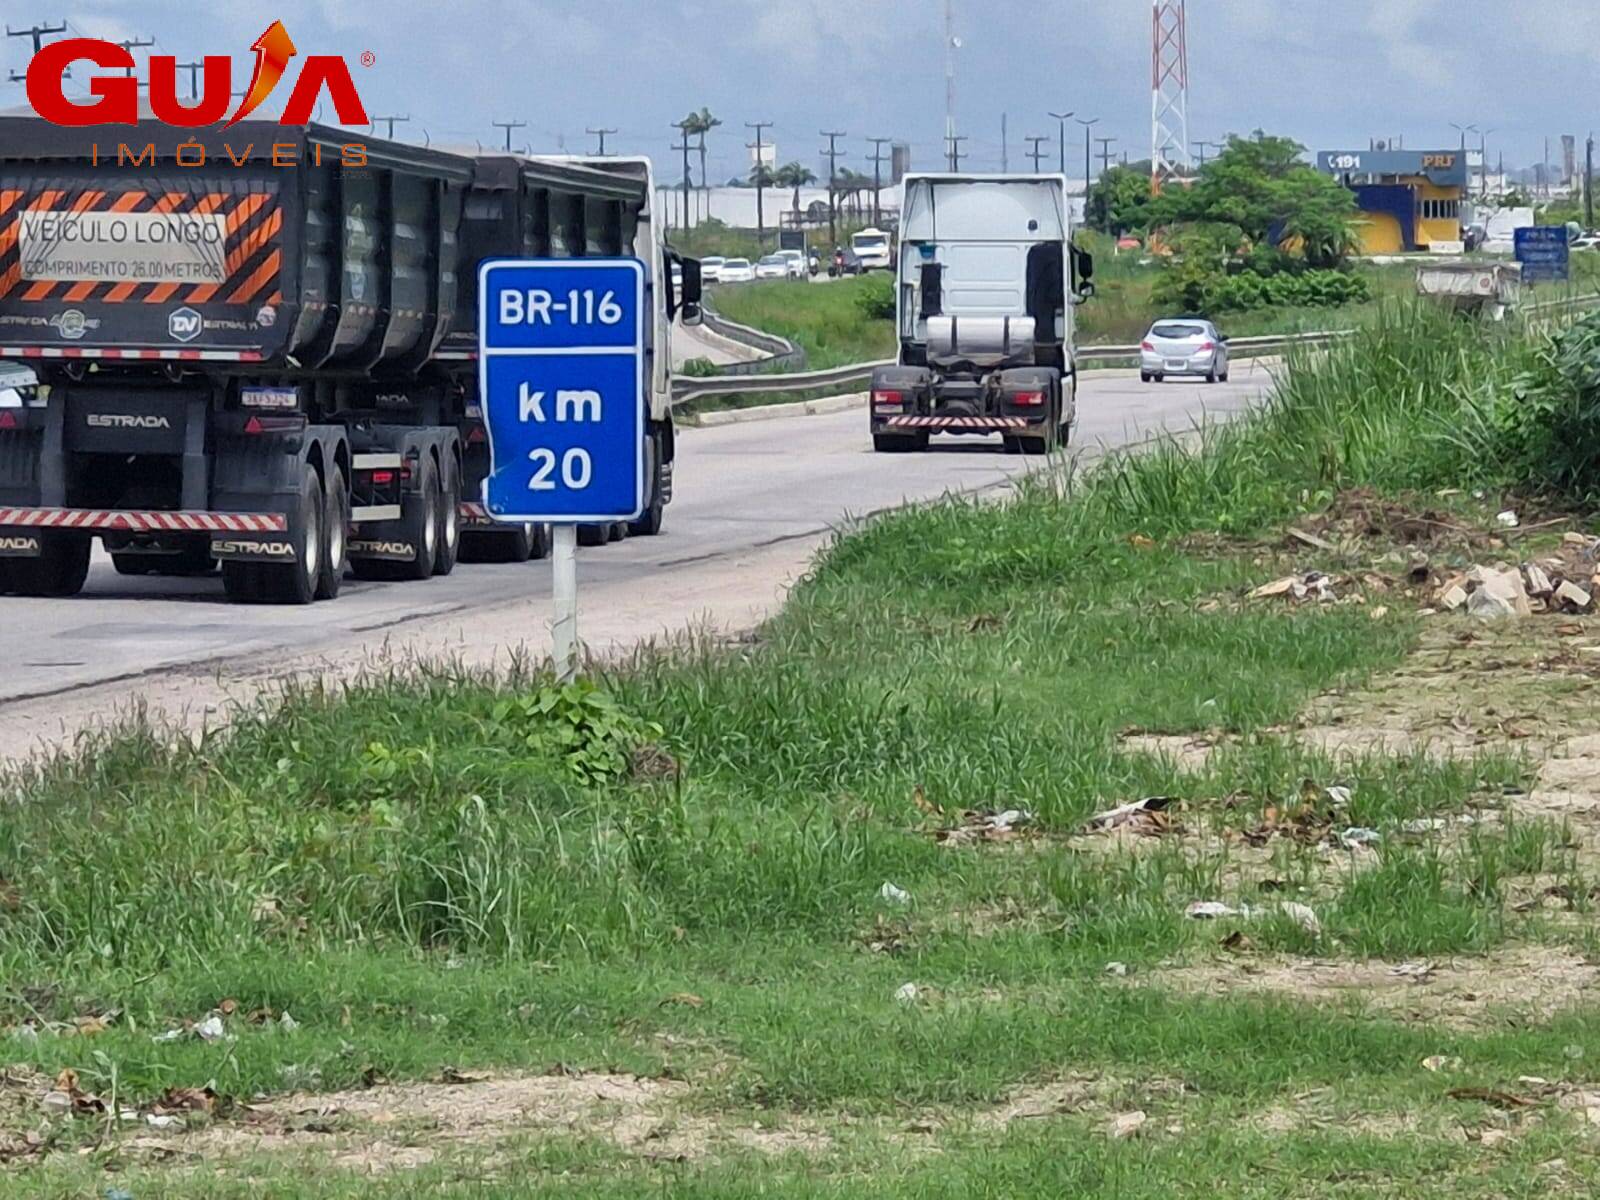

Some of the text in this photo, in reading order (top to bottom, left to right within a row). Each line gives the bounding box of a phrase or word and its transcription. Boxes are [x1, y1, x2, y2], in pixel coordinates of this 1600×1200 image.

[1336, 155, 1361, 168] 191
[24, 215, 221, 244] VEÍCULO LONGO
[24, 260, 128, 277] COMPRIMENTO
[163, 262, 220, 279] METROS
[499, 289, 623, 325] BR-116
[518, 381, 602, 423] km
[86, 414, 171, 428] ESTRADA
[527, 447, 593, 490] 20
[211, 540, 294, 555] ESTRADA
